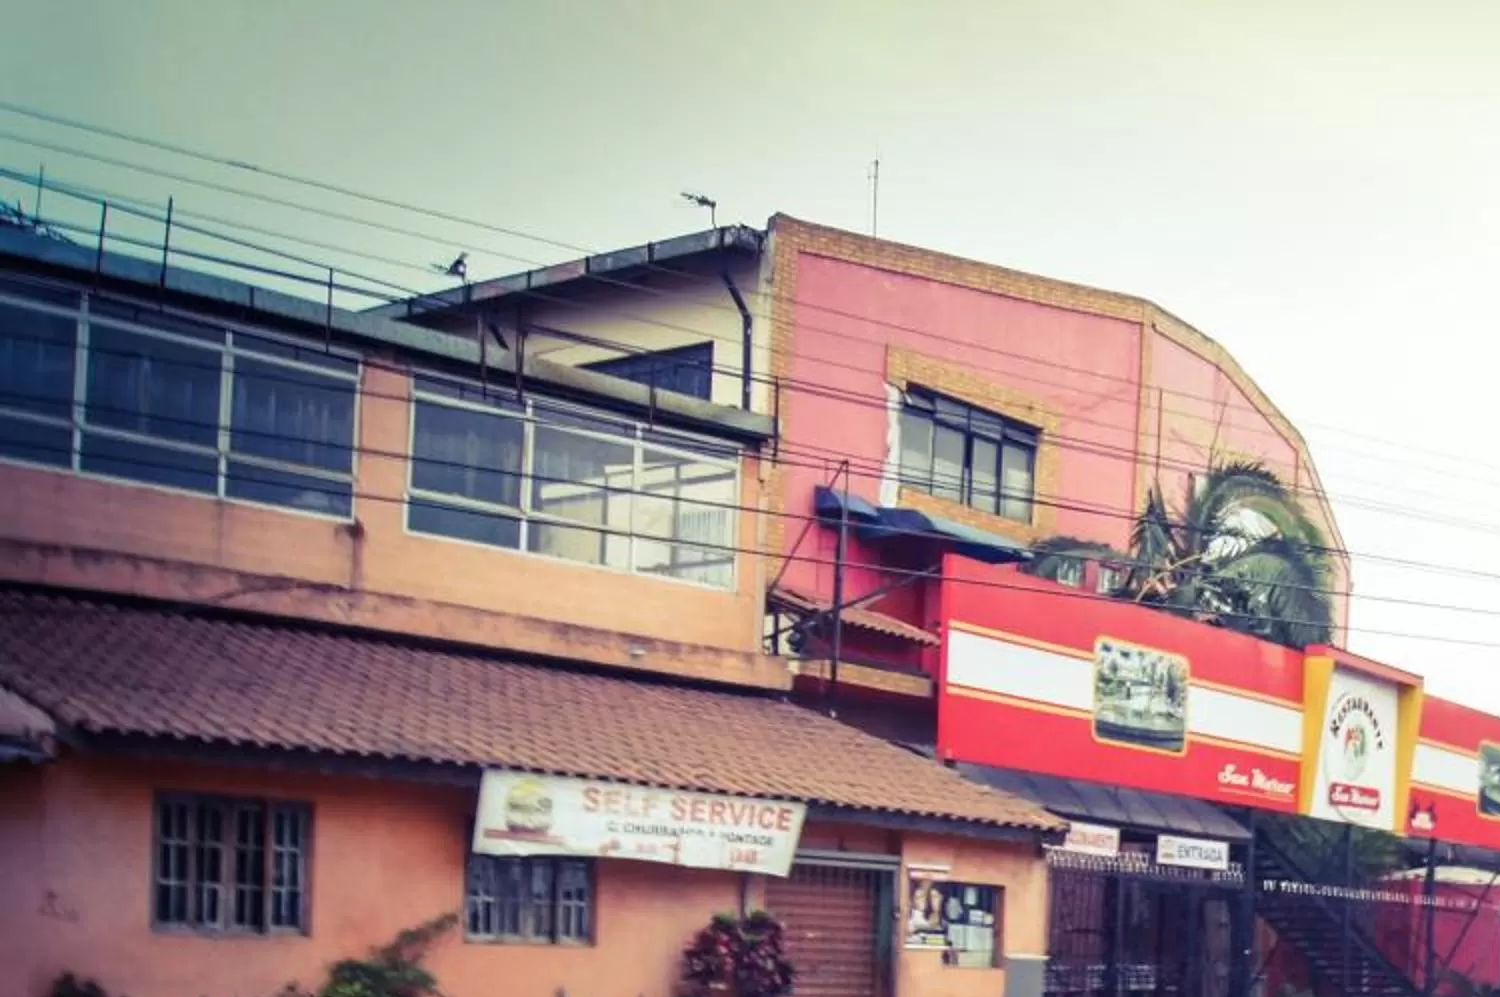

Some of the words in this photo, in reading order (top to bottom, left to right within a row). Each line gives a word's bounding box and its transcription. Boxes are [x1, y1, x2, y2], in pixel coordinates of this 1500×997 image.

[582, 786, 658, 819] SELF
[670, 796, 794, 832] SERVICE
[1177, 843, 1223, 862] ENTRADA
